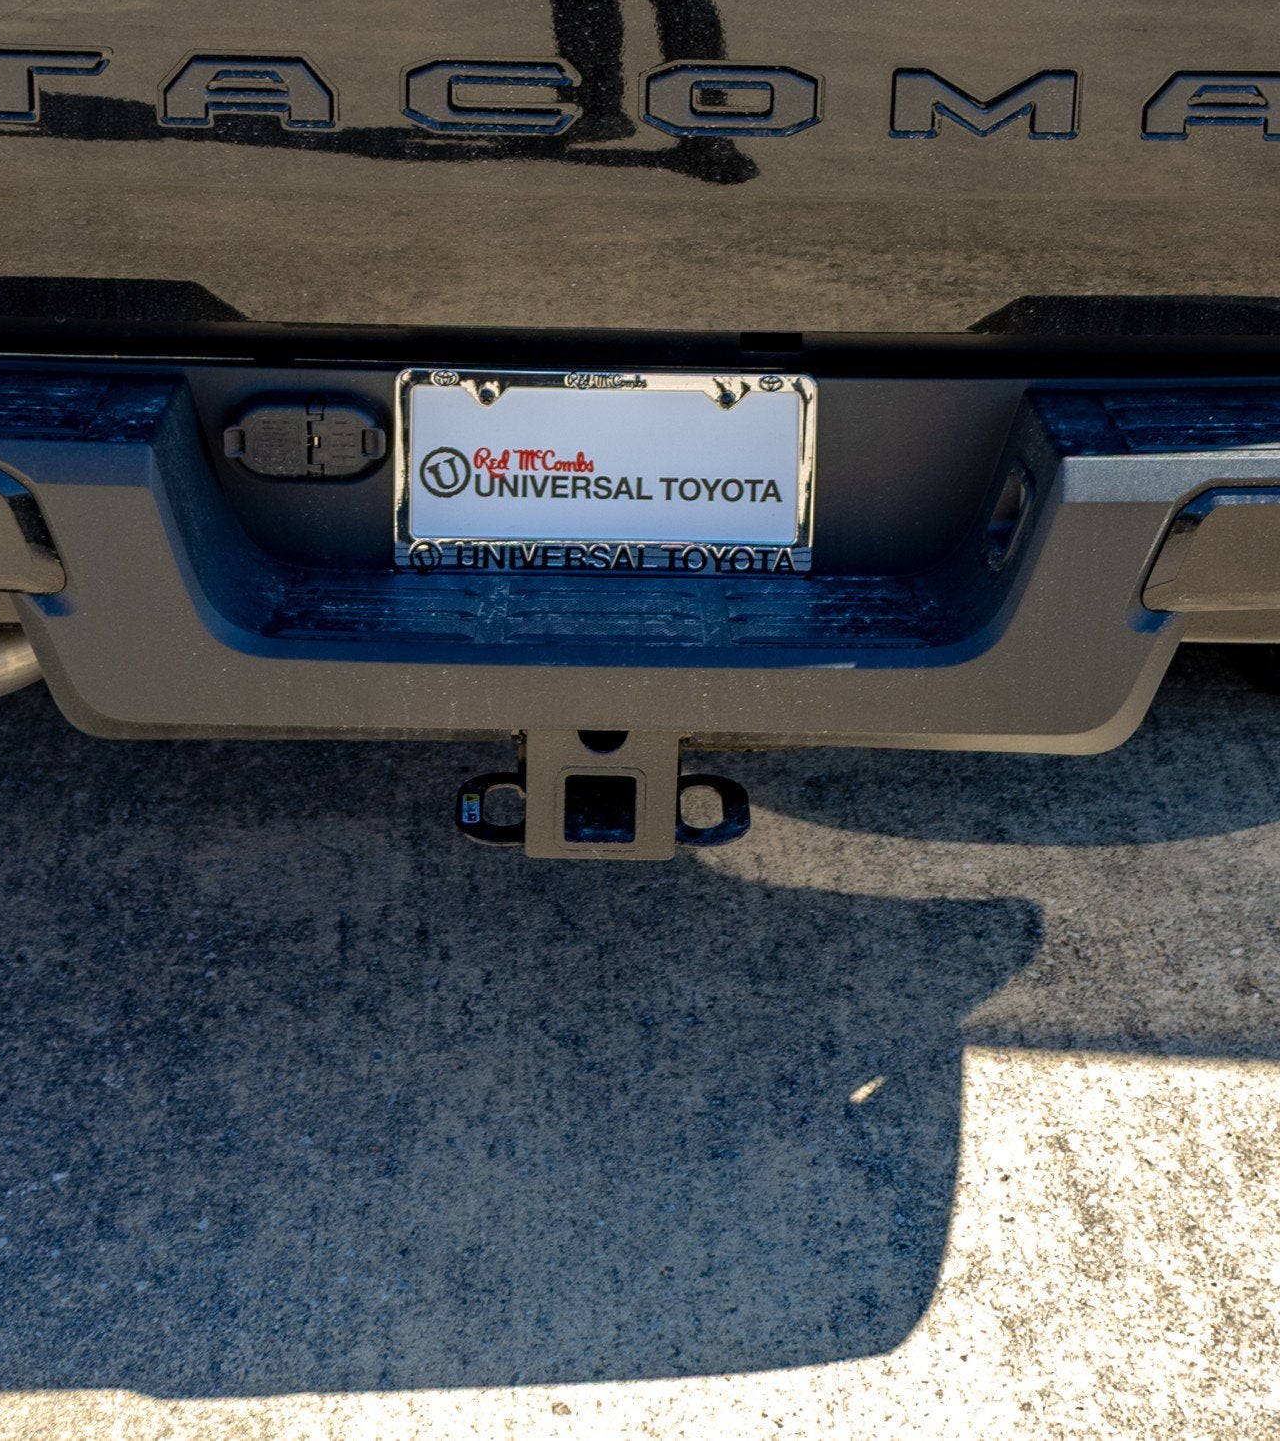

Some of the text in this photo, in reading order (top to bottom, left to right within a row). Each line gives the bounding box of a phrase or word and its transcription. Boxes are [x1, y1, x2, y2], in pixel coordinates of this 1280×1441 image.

[565, 372, 590, 389] Red
[473, 447, 595, 479] Red McCombs
[474, 473, 783, 503] UNIVERSAL TOYOTA
[455, 541, 658, 571] UNIVERSAL
[661, 545, 796, 574] TOYOTA
